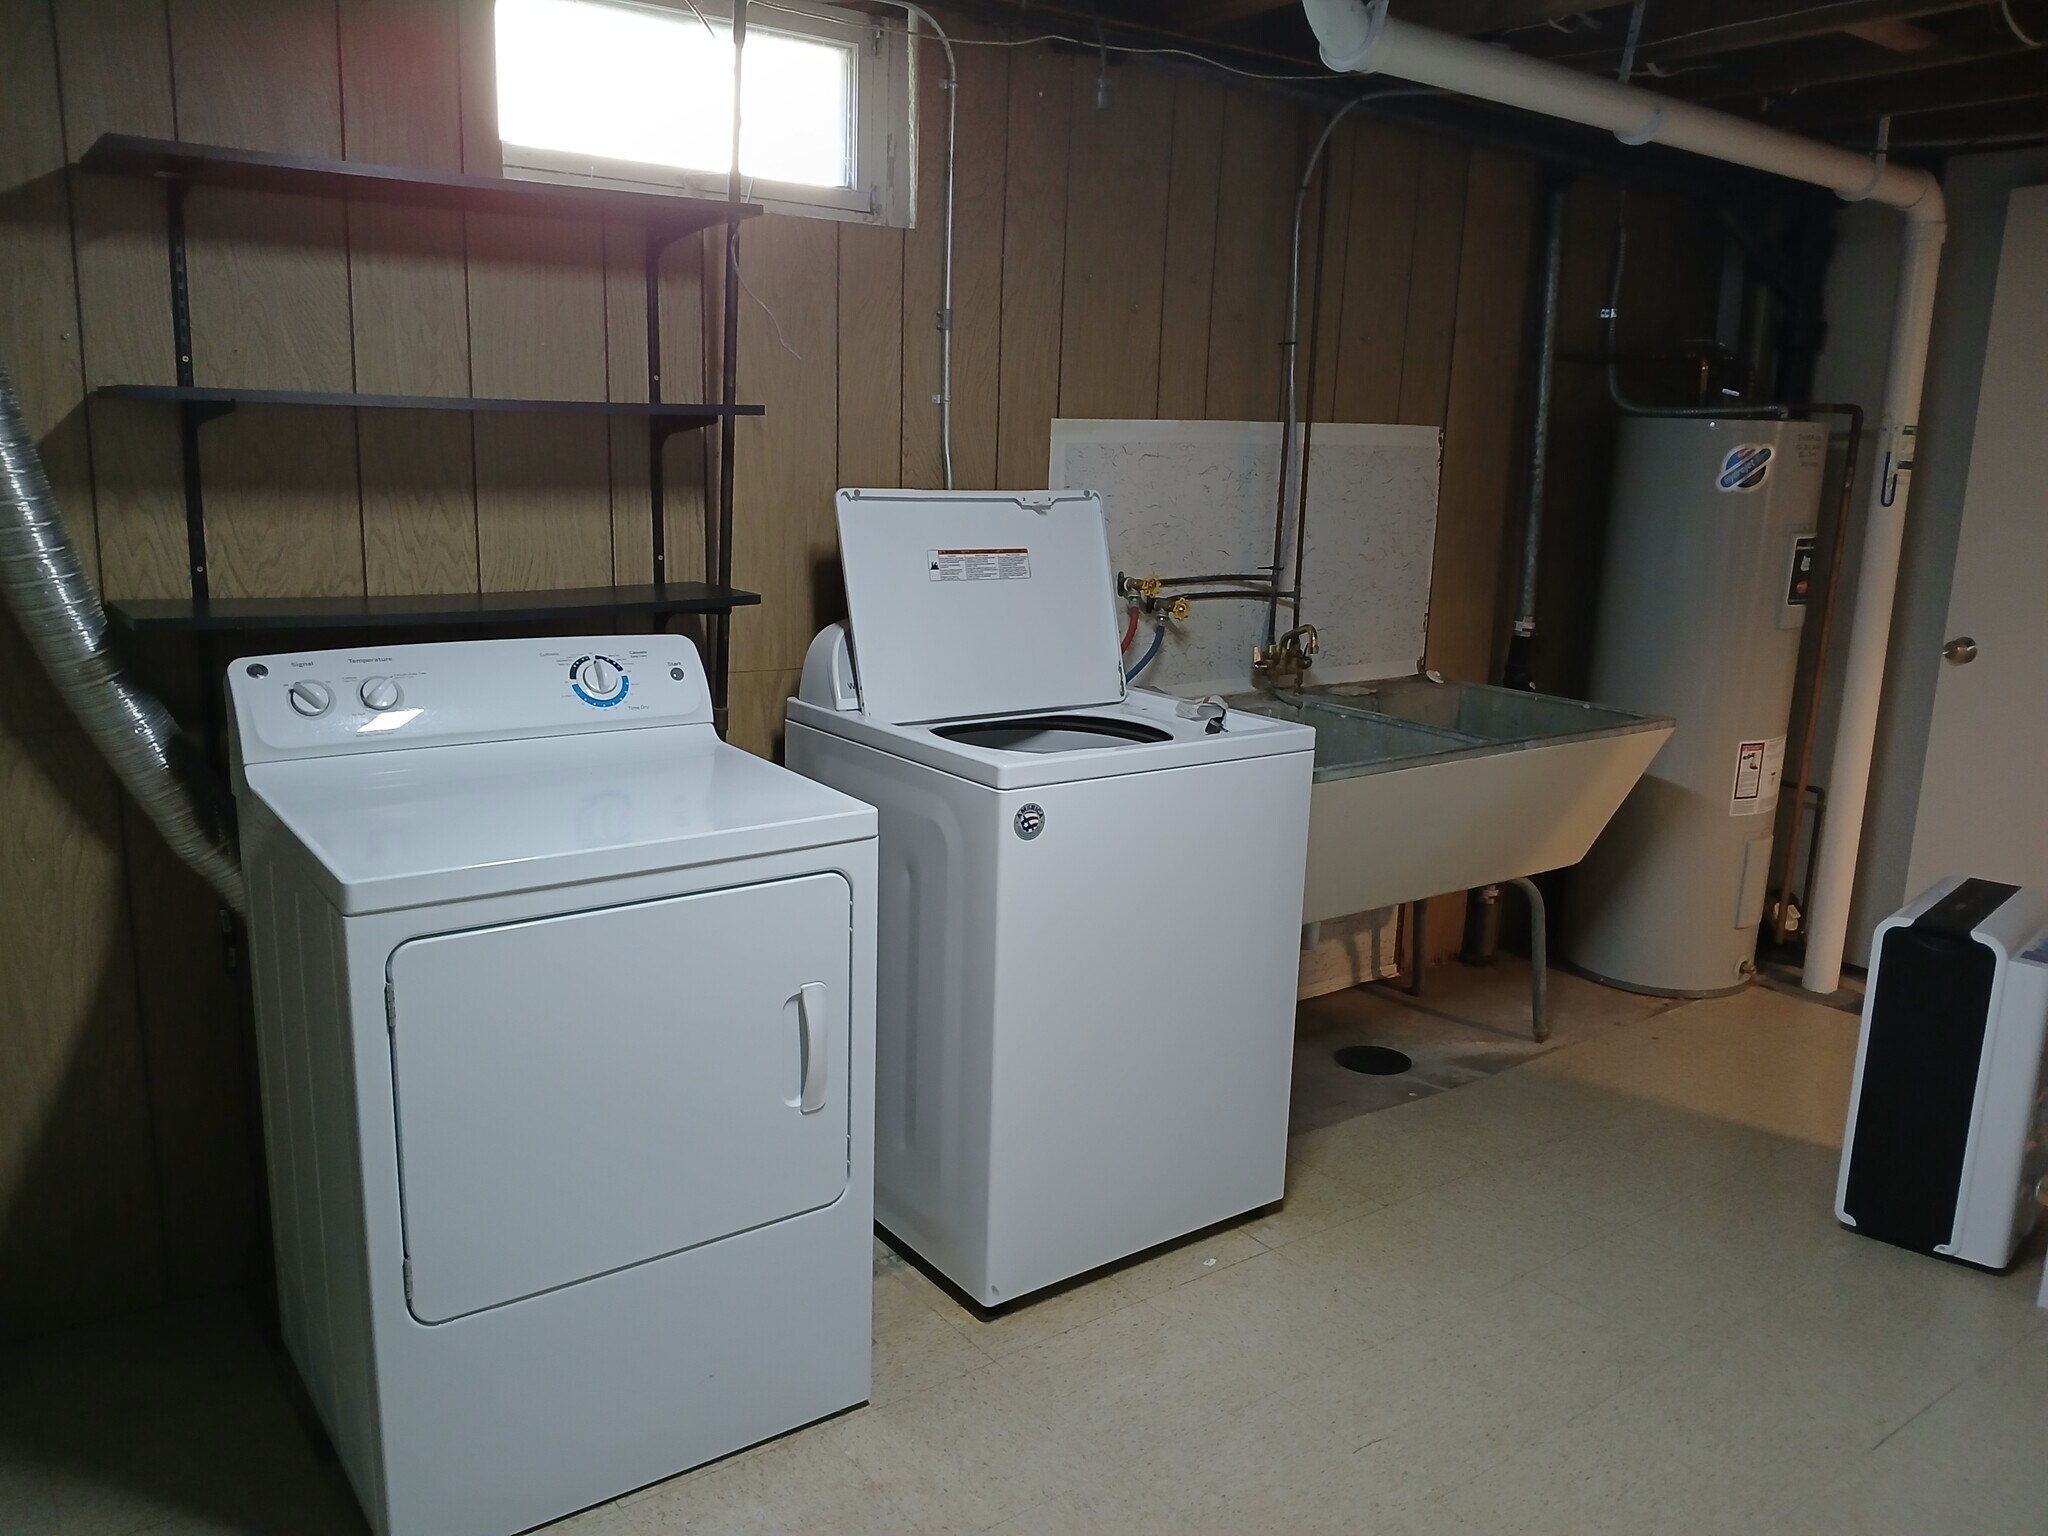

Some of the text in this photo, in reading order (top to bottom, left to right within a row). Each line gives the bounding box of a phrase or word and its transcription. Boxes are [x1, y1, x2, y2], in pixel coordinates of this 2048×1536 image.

[290, 660, 314, 668] Signal
[348, 656, 393, 664] Temperature
[1017, 804, 1044, 819] AMERICA
